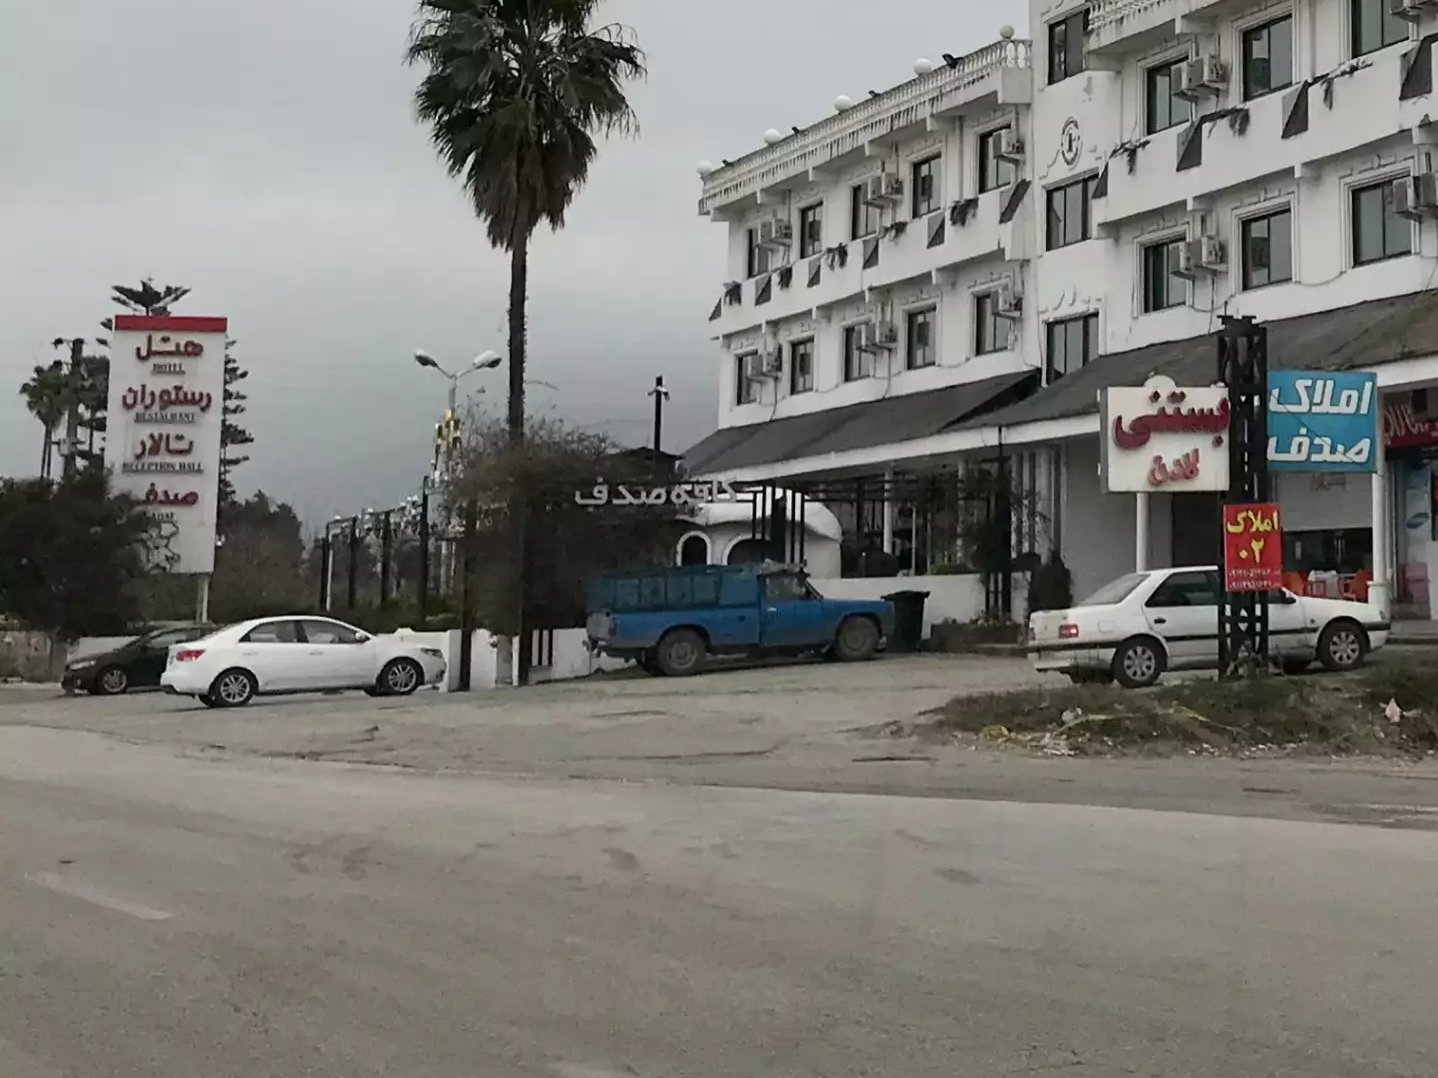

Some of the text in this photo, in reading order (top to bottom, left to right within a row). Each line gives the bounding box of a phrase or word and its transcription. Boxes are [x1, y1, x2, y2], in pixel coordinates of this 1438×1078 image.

[136, 333, 203, 360] هتل
[122, 384, 212, 413] رستوران
[1269, 379, 1373, 414] املاک
[1112, 390, 1230, 450] بستنی
[134, 432, 194, 460] تالار
[1267, 427, 1371, 463] صدف
[142, 482, 199, 505] صدف
[574, 476, 667, 506] صدف
[1227, 509, 1279, 533] املاک
